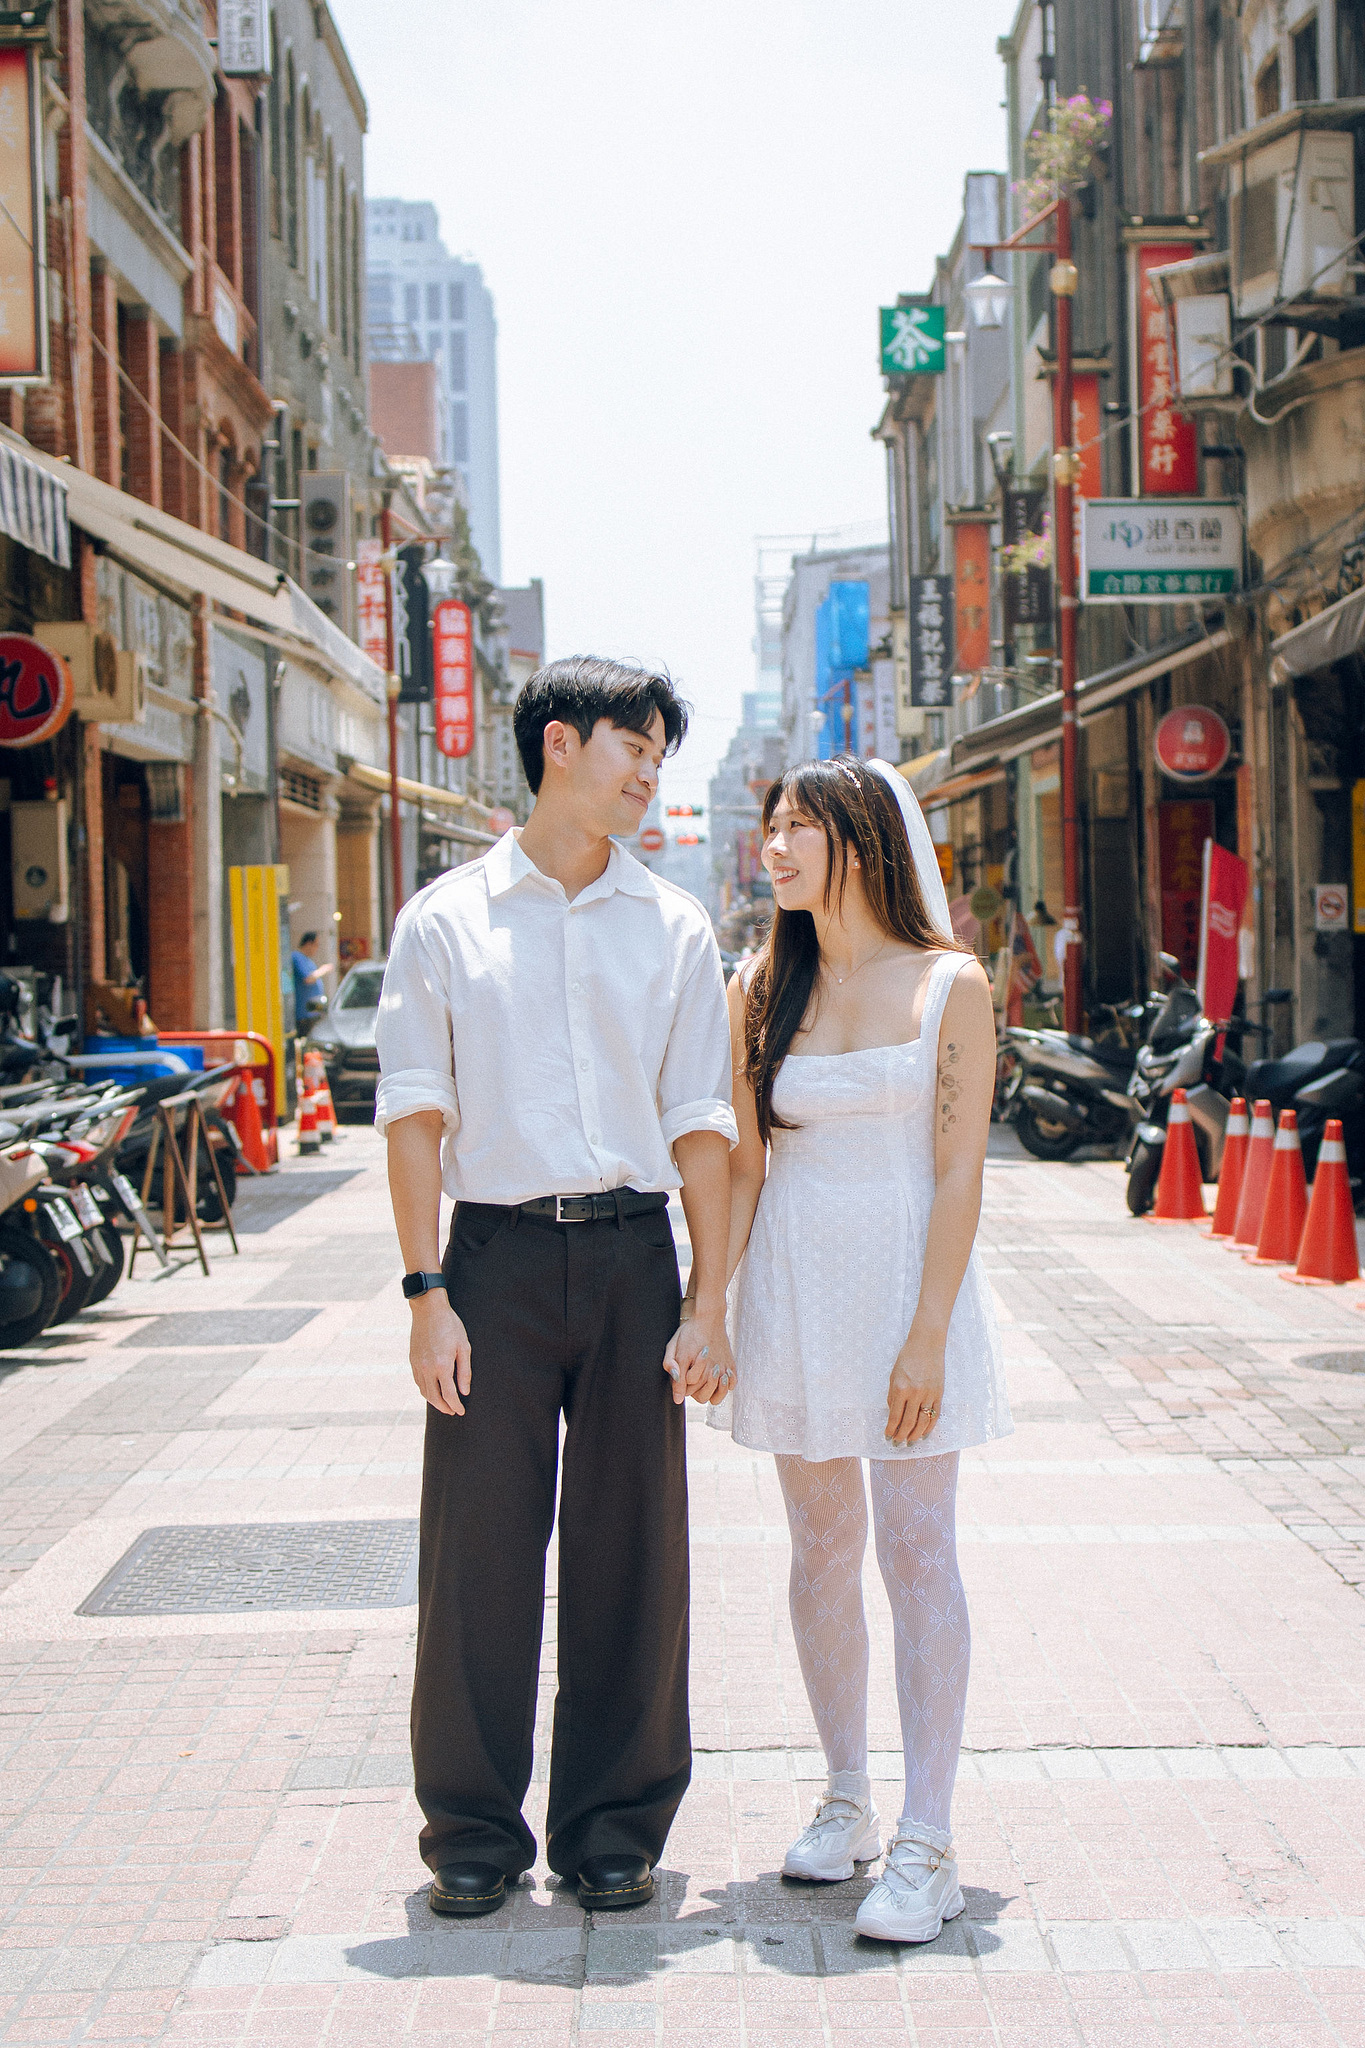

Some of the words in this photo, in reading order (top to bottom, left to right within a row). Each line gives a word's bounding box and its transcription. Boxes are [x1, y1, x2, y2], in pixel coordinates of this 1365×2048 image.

[885, 309, 939, 370] 茶
[1147, 518, 1222, 540] 港香蘭
